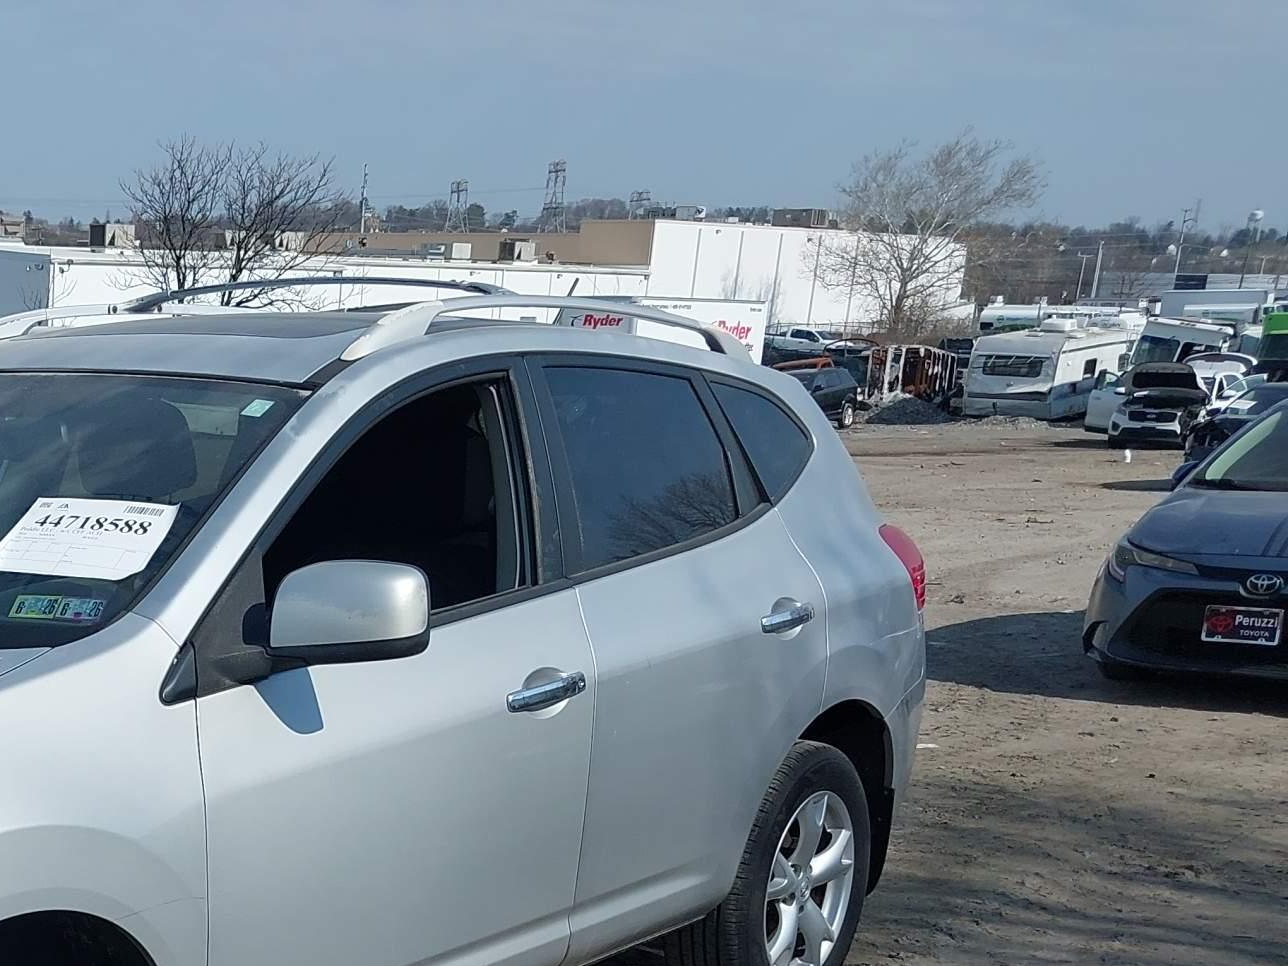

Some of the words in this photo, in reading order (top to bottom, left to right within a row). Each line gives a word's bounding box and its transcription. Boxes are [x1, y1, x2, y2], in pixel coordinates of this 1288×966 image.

[582, 314, 623, 329] Ryder
[718, 320, 752, 340] der
[34, 513, 152, 536] 44718588
[1235, 614, 1278, 628] Peruzzi
[1240, 629, 1269, 637] TOYOTA
